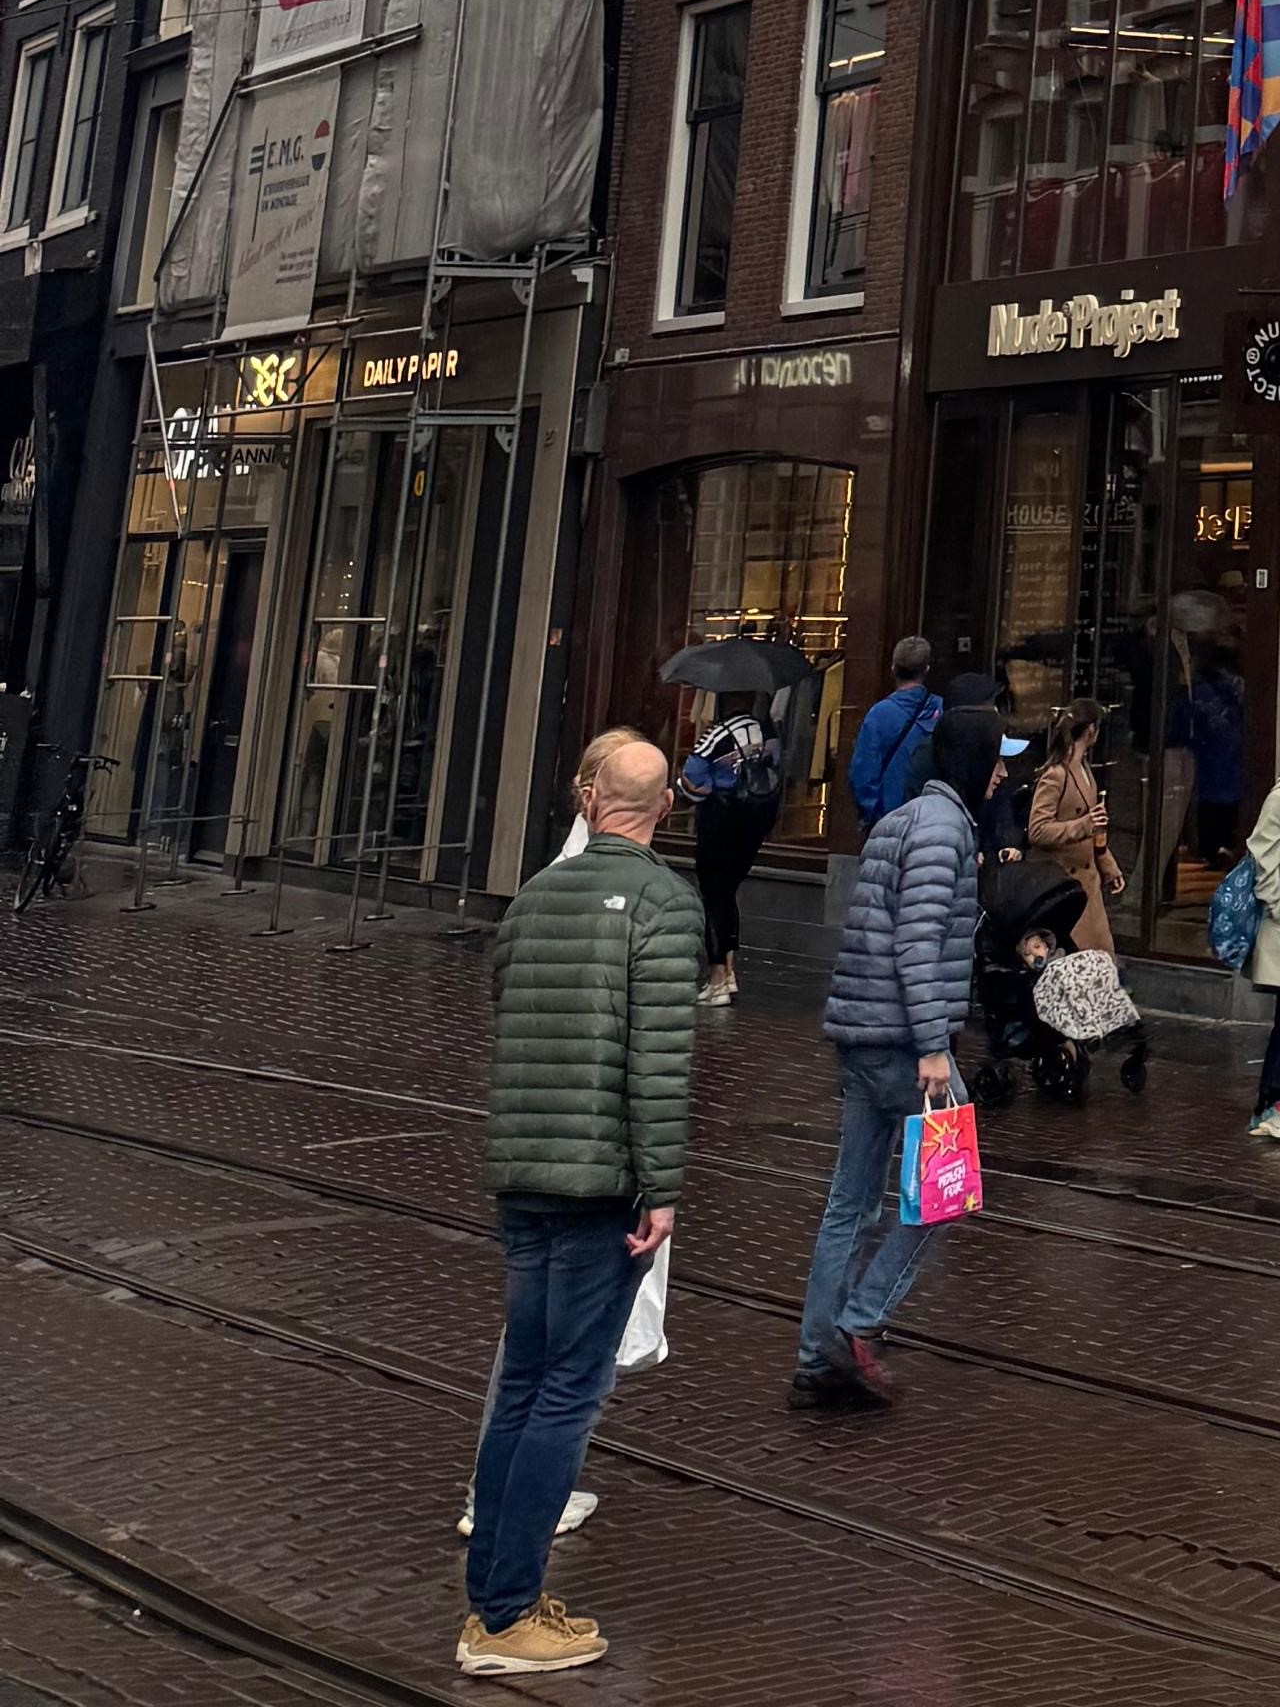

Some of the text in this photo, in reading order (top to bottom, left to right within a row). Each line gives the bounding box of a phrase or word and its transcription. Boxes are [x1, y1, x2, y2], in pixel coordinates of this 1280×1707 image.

[987, 289, 1181, 358] Nude Project
[363, 350, 459, 387] DAILY PPR
[1006, 503, 1069, 526] HOUSE
